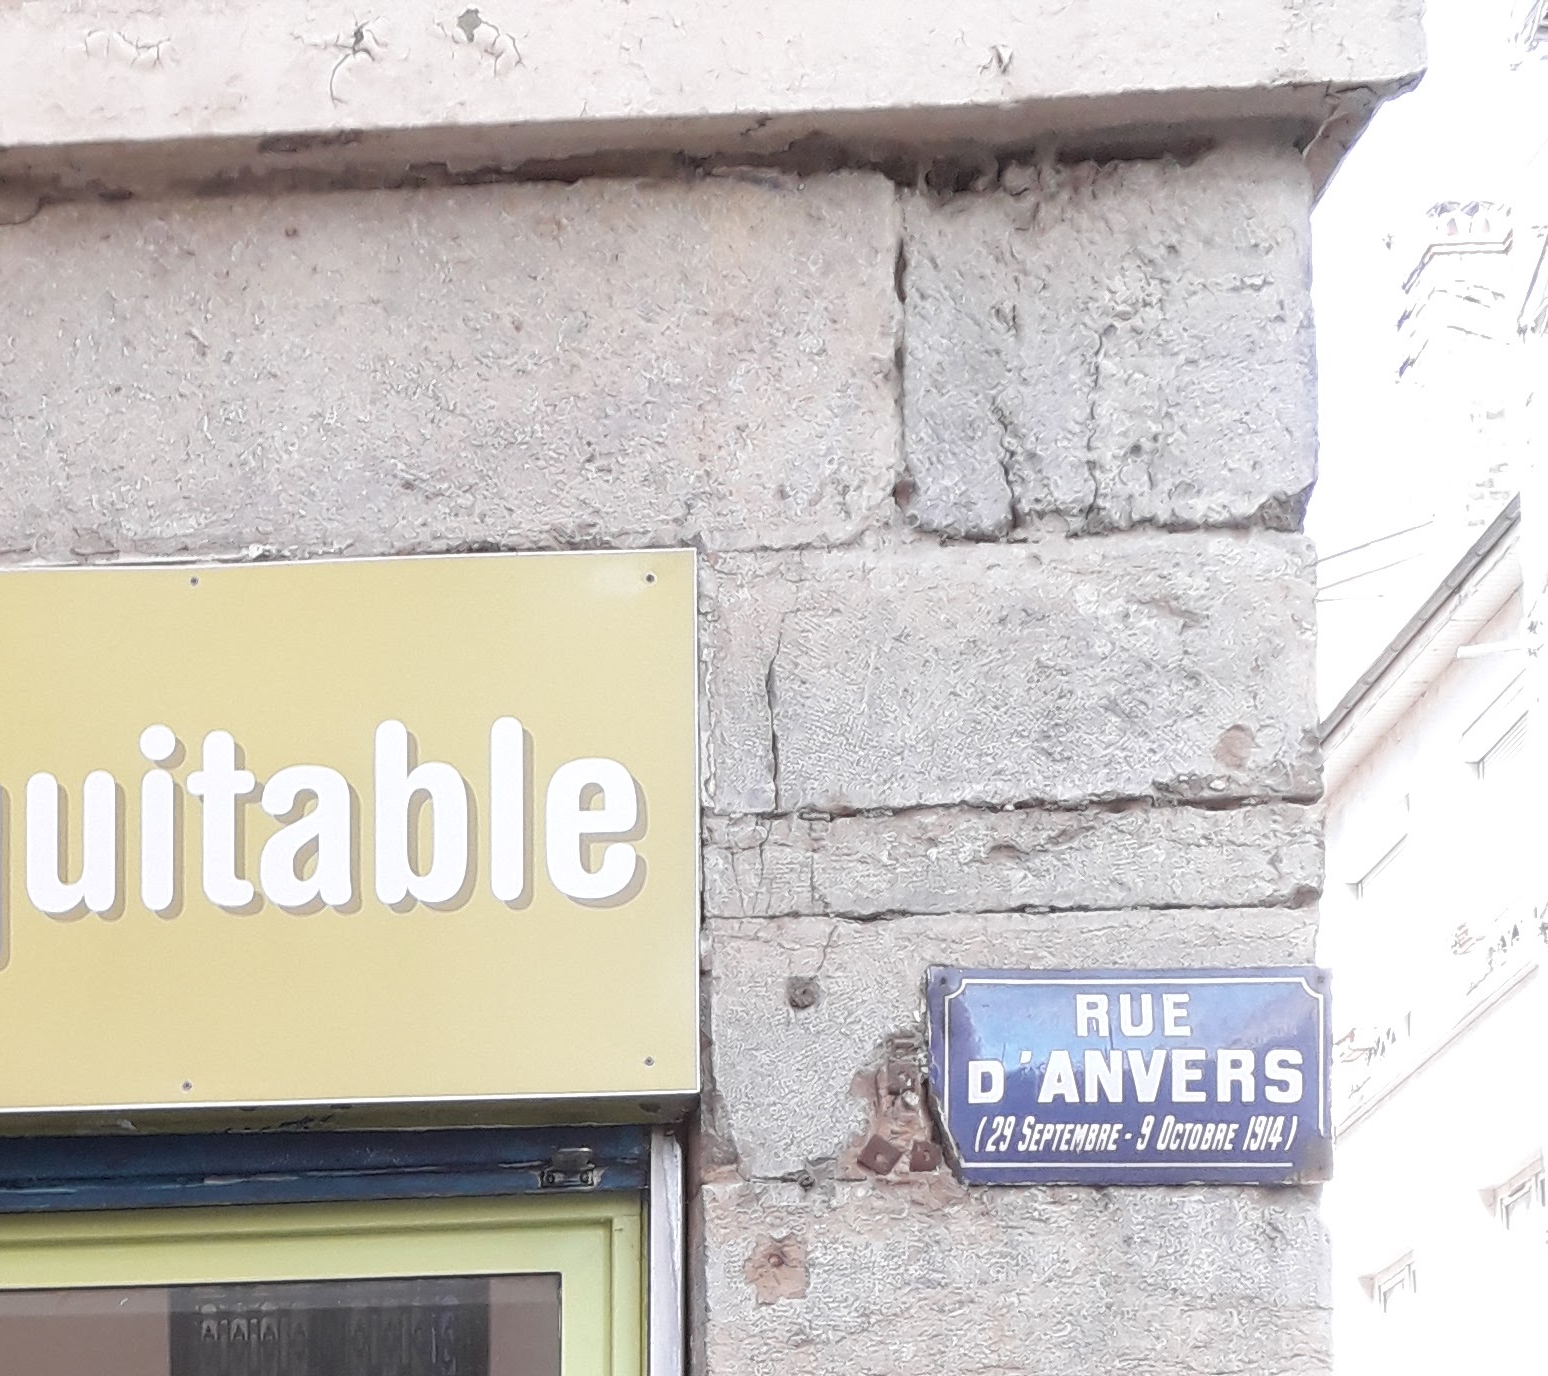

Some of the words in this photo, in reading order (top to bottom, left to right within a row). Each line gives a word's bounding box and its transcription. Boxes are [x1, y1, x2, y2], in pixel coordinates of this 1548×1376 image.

[1075, 992, 1192, 1038] RUE
[967, 1048, 1304, 1104] D'ANVERS
[1135, 1115, 1150, 1151] 9
